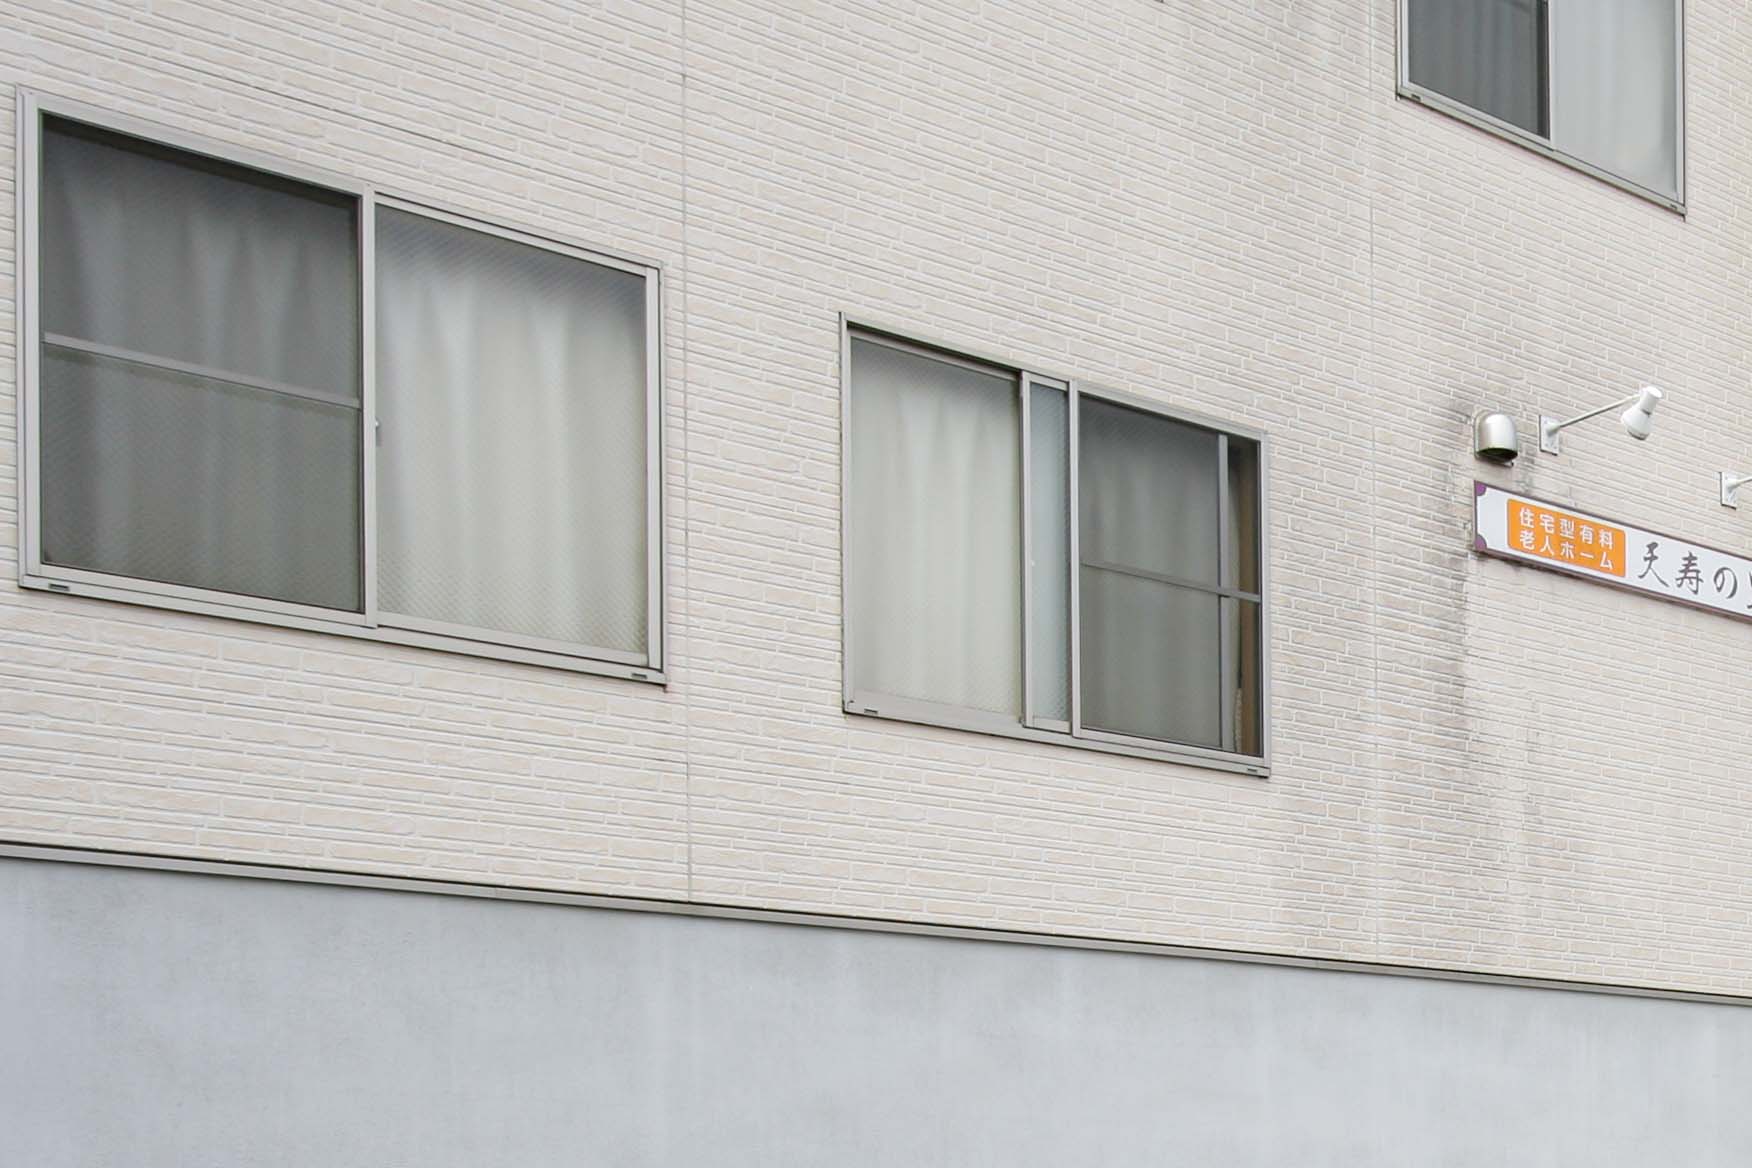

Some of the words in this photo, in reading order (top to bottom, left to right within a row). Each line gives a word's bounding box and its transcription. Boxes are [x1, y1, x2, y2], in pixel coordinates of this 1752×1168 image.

[1519, 507, 1614, 550] 住宅型有料
[1519, 529, 1614, 571] 老人ホーム
